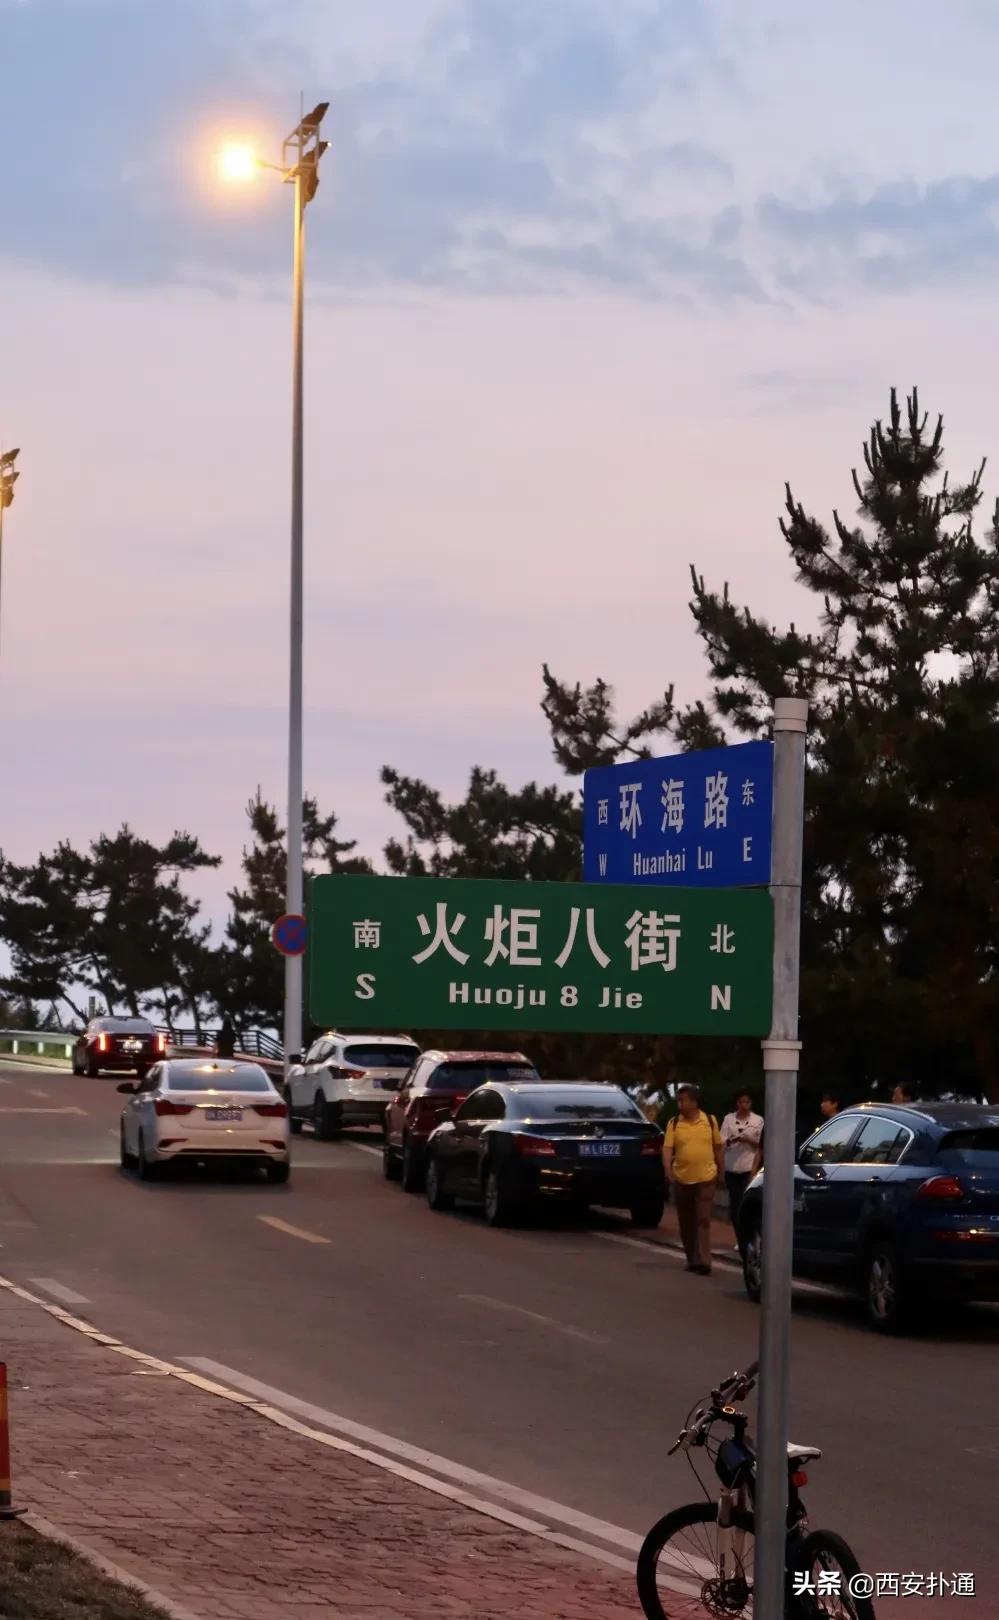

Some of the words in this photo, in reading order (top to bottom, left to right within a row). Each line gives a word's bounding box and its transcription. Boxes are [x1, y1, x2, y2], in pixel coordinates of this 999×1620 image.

[597, 799, 608, 825] 西
[619, 771, 729, 839] 环海路
[741, 779, 755, 806] 东
[599, 853, 608, 876] W
[633, 848, 686, 876] Huanhai
[697, 846, 713, 870] Lu
[743, 837, 753, 862] E
[352, 919, 381, 949] 南
[412, 902, 681, 972] 火炬八街
[709, 923, 736, 954] 北
[355, 973, 376, 1000] S
[449, 982, 546, 1010] Huoju
[560, 985, 578, 1007] 8
[598, 987, 643, 1008] Jie
[711, 984, 731, 1010] N
